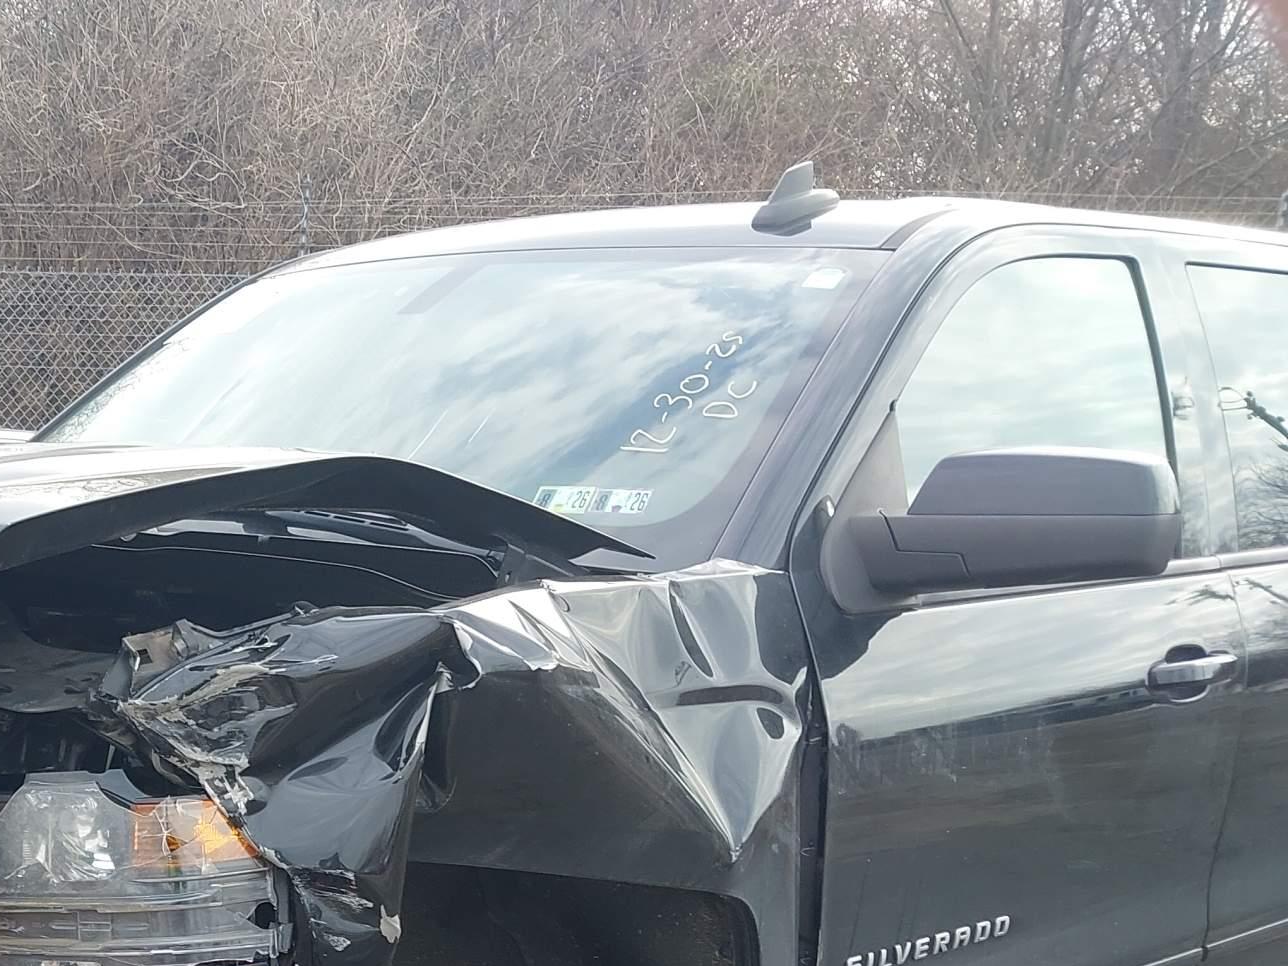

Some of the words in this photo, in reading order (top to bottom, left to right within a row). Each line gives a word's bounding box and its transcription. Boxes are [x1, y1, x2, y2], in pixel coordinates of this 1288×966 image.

[620, 331, 743, 453] 12-30-25
[703, 380, 757, 419] DC
[572, 490, 591, 509] 26
[630, 492, 649, 511] 26
